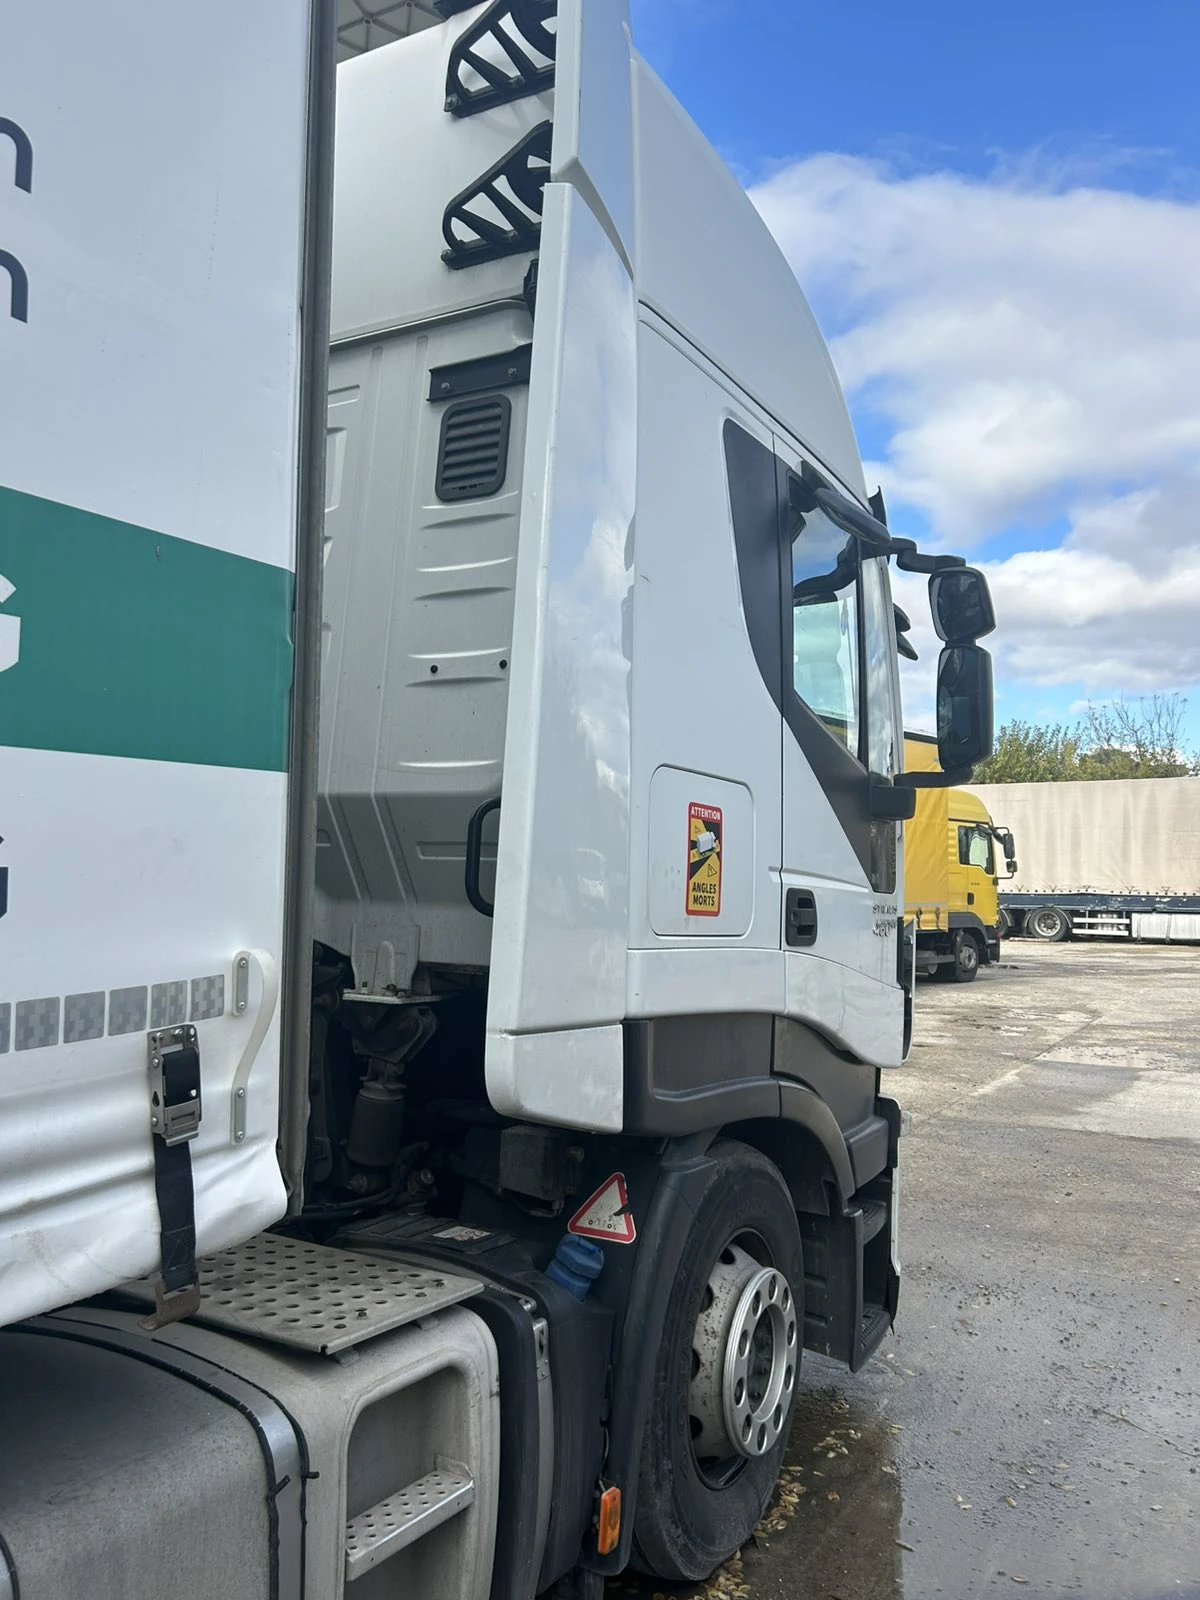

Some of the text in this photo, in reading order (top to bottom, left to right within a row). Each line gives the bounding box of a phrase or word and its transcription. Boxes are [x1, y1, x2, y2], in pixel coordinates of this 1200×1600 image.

[691, 806, 720, 820] ATTENTION
[692, 881, 717, 895] ANGLES
[692, 894, 716, 907] MORTS
